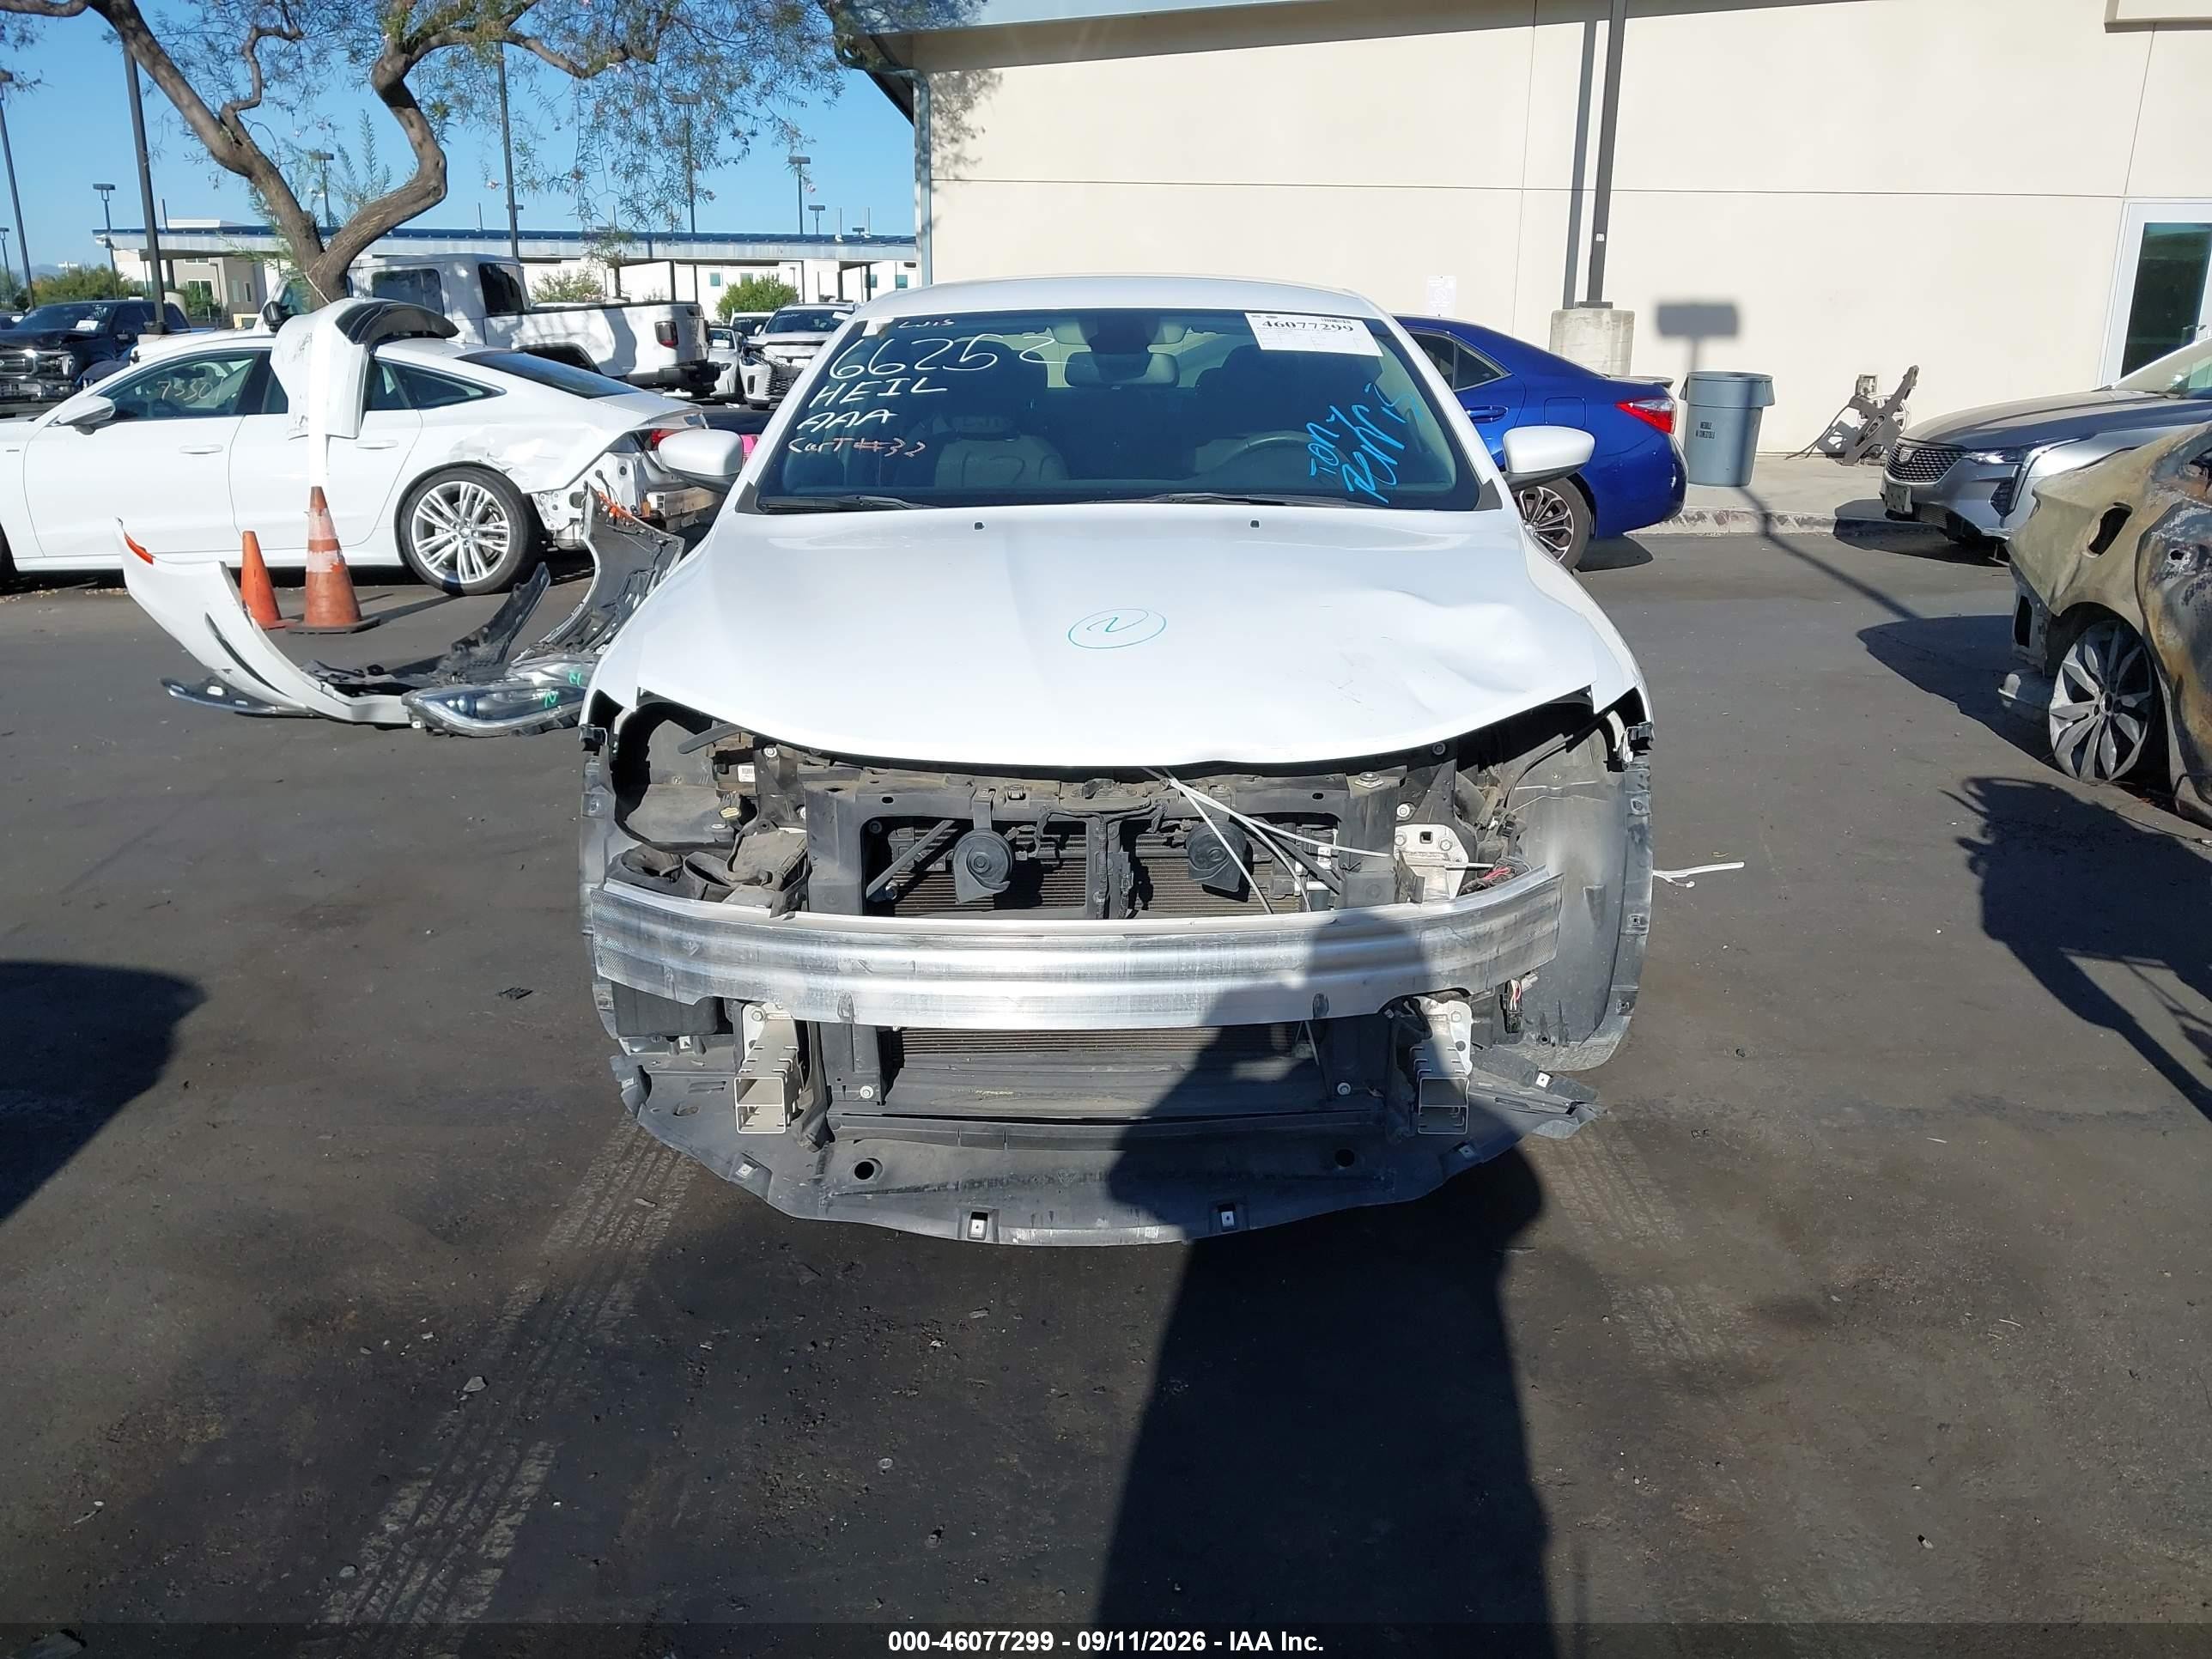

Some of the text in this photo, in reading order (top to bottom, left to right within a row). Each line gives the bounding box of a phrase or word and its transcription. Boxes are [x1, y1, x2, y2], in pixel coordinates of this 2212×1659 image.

[1261, 320, 1354, 331] 46077299
[808, 377, 948, 409] HEIL
[796, 409, 899, 433] AAA
